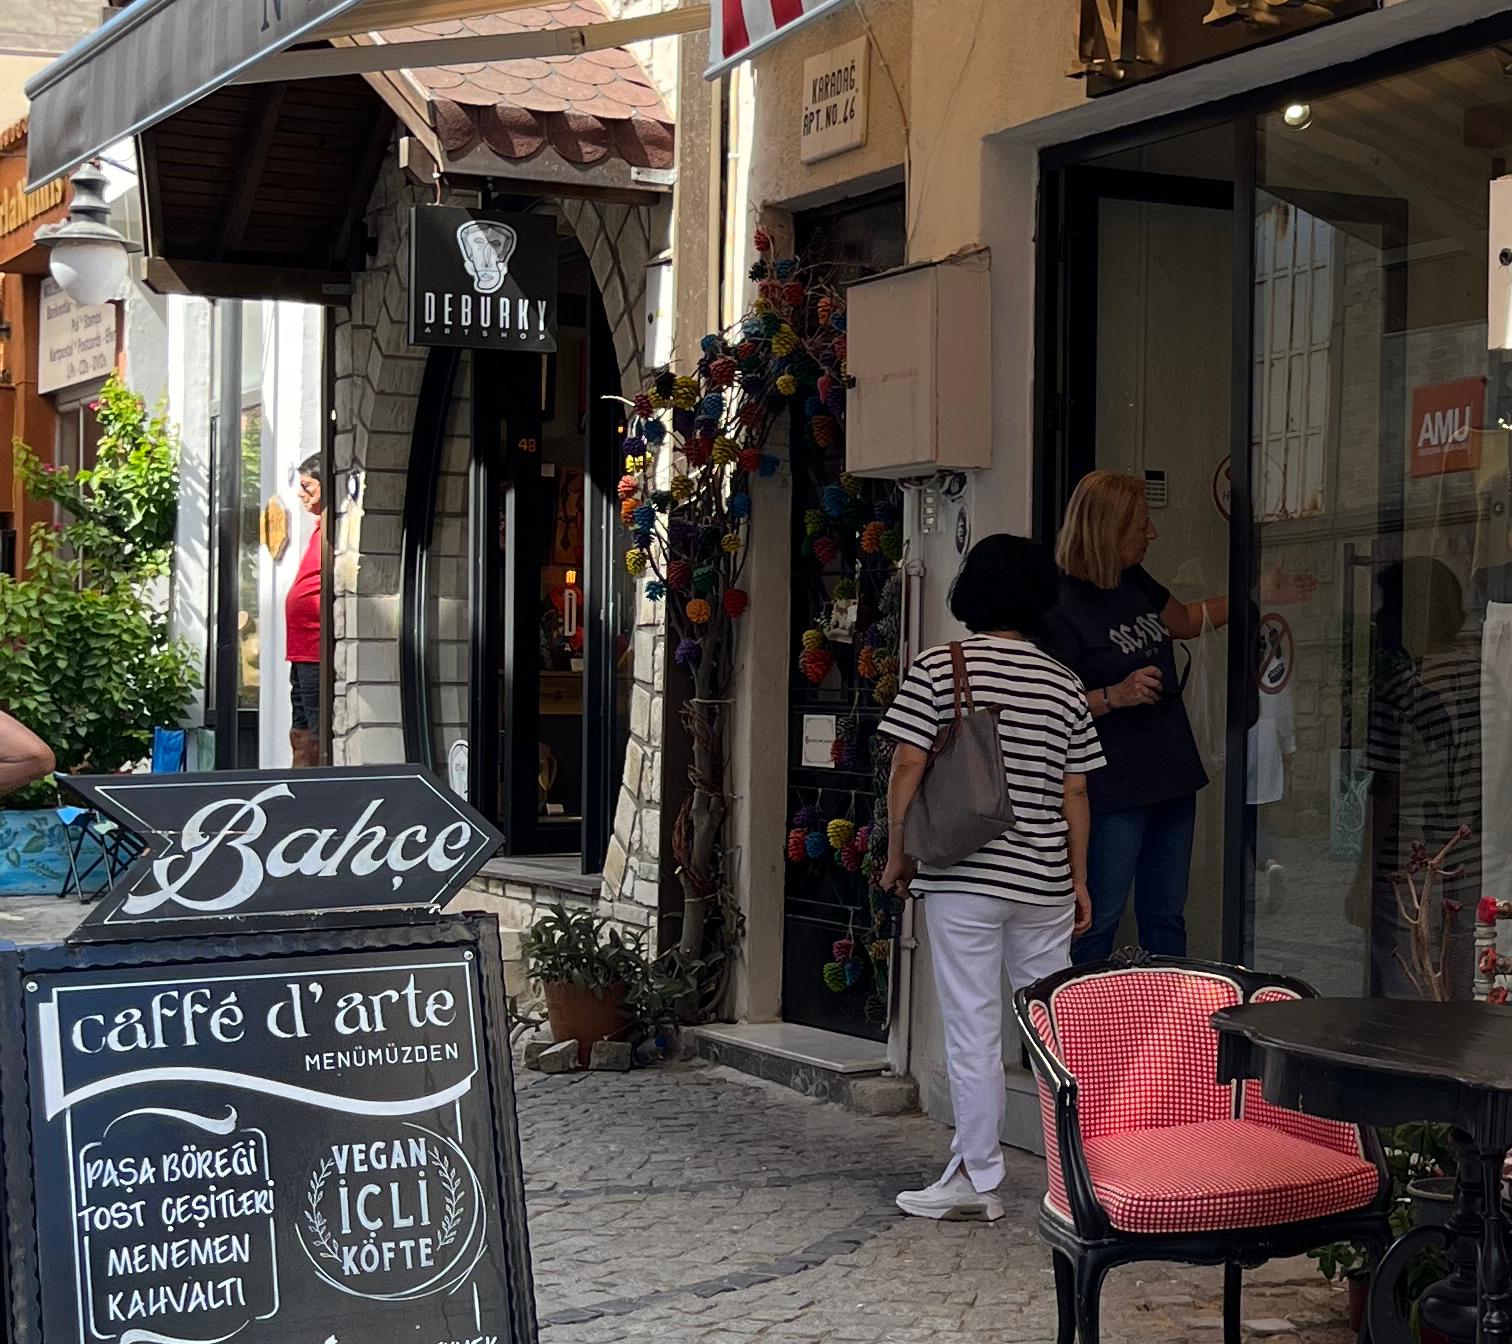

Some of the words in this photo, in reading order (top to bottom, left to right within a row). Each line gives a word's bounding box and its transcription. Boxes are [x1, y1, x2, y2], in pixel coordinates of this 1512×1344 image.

[424, 292, 547, 331] DEBURKY
[1417, 406, 1471, 448] AMU
[122, 783, 472, 915] Bahçe
[71, 989, 246, 1054] caffé
[266, 973, 457, 1039] d'arte
[305, 1043, 459, 1072] MENÜMÜZDEN
[86, 1157, 156, 1193] PAŞA
[163, 1140, 258, 1182] BÖREĞİ
[331, 1138, 428, 1174] VEGAN
[78, 1200, 146, 1232] TOST
[162, 1179, 275, 1233] ÇEŞİTLERİ
[338, 1171, 431, 1239] İÇLİ
[107, 1233, 250, 1277] MENEMEN
[341, 1237, 434, 1276] KÖFTE
[108, 1277, 247, 1321] KAHVALTI
